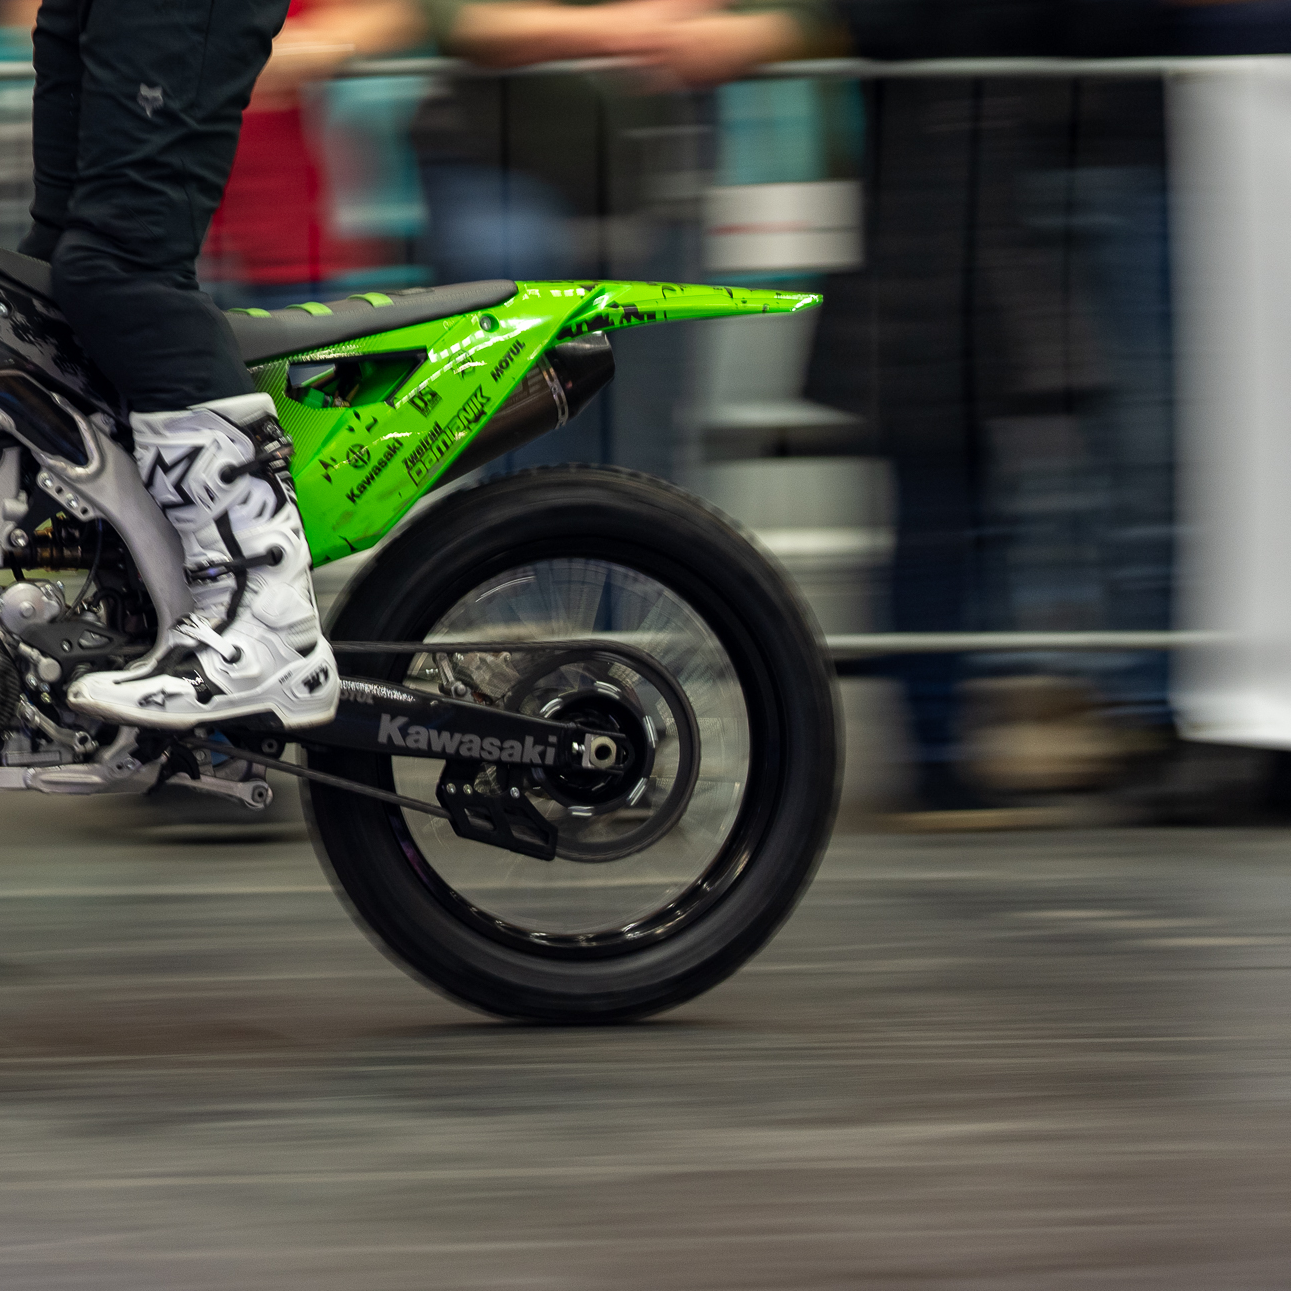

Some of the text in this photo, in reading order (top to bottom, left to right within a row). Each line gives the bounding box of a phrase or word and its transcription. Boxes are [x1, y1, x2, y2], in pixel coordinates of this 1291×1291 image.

[490, 338, 527, 383] MOTUL
[345, 437, 404, 505] Kawasaki
[377, 712, 558, 766] Kawasaki
